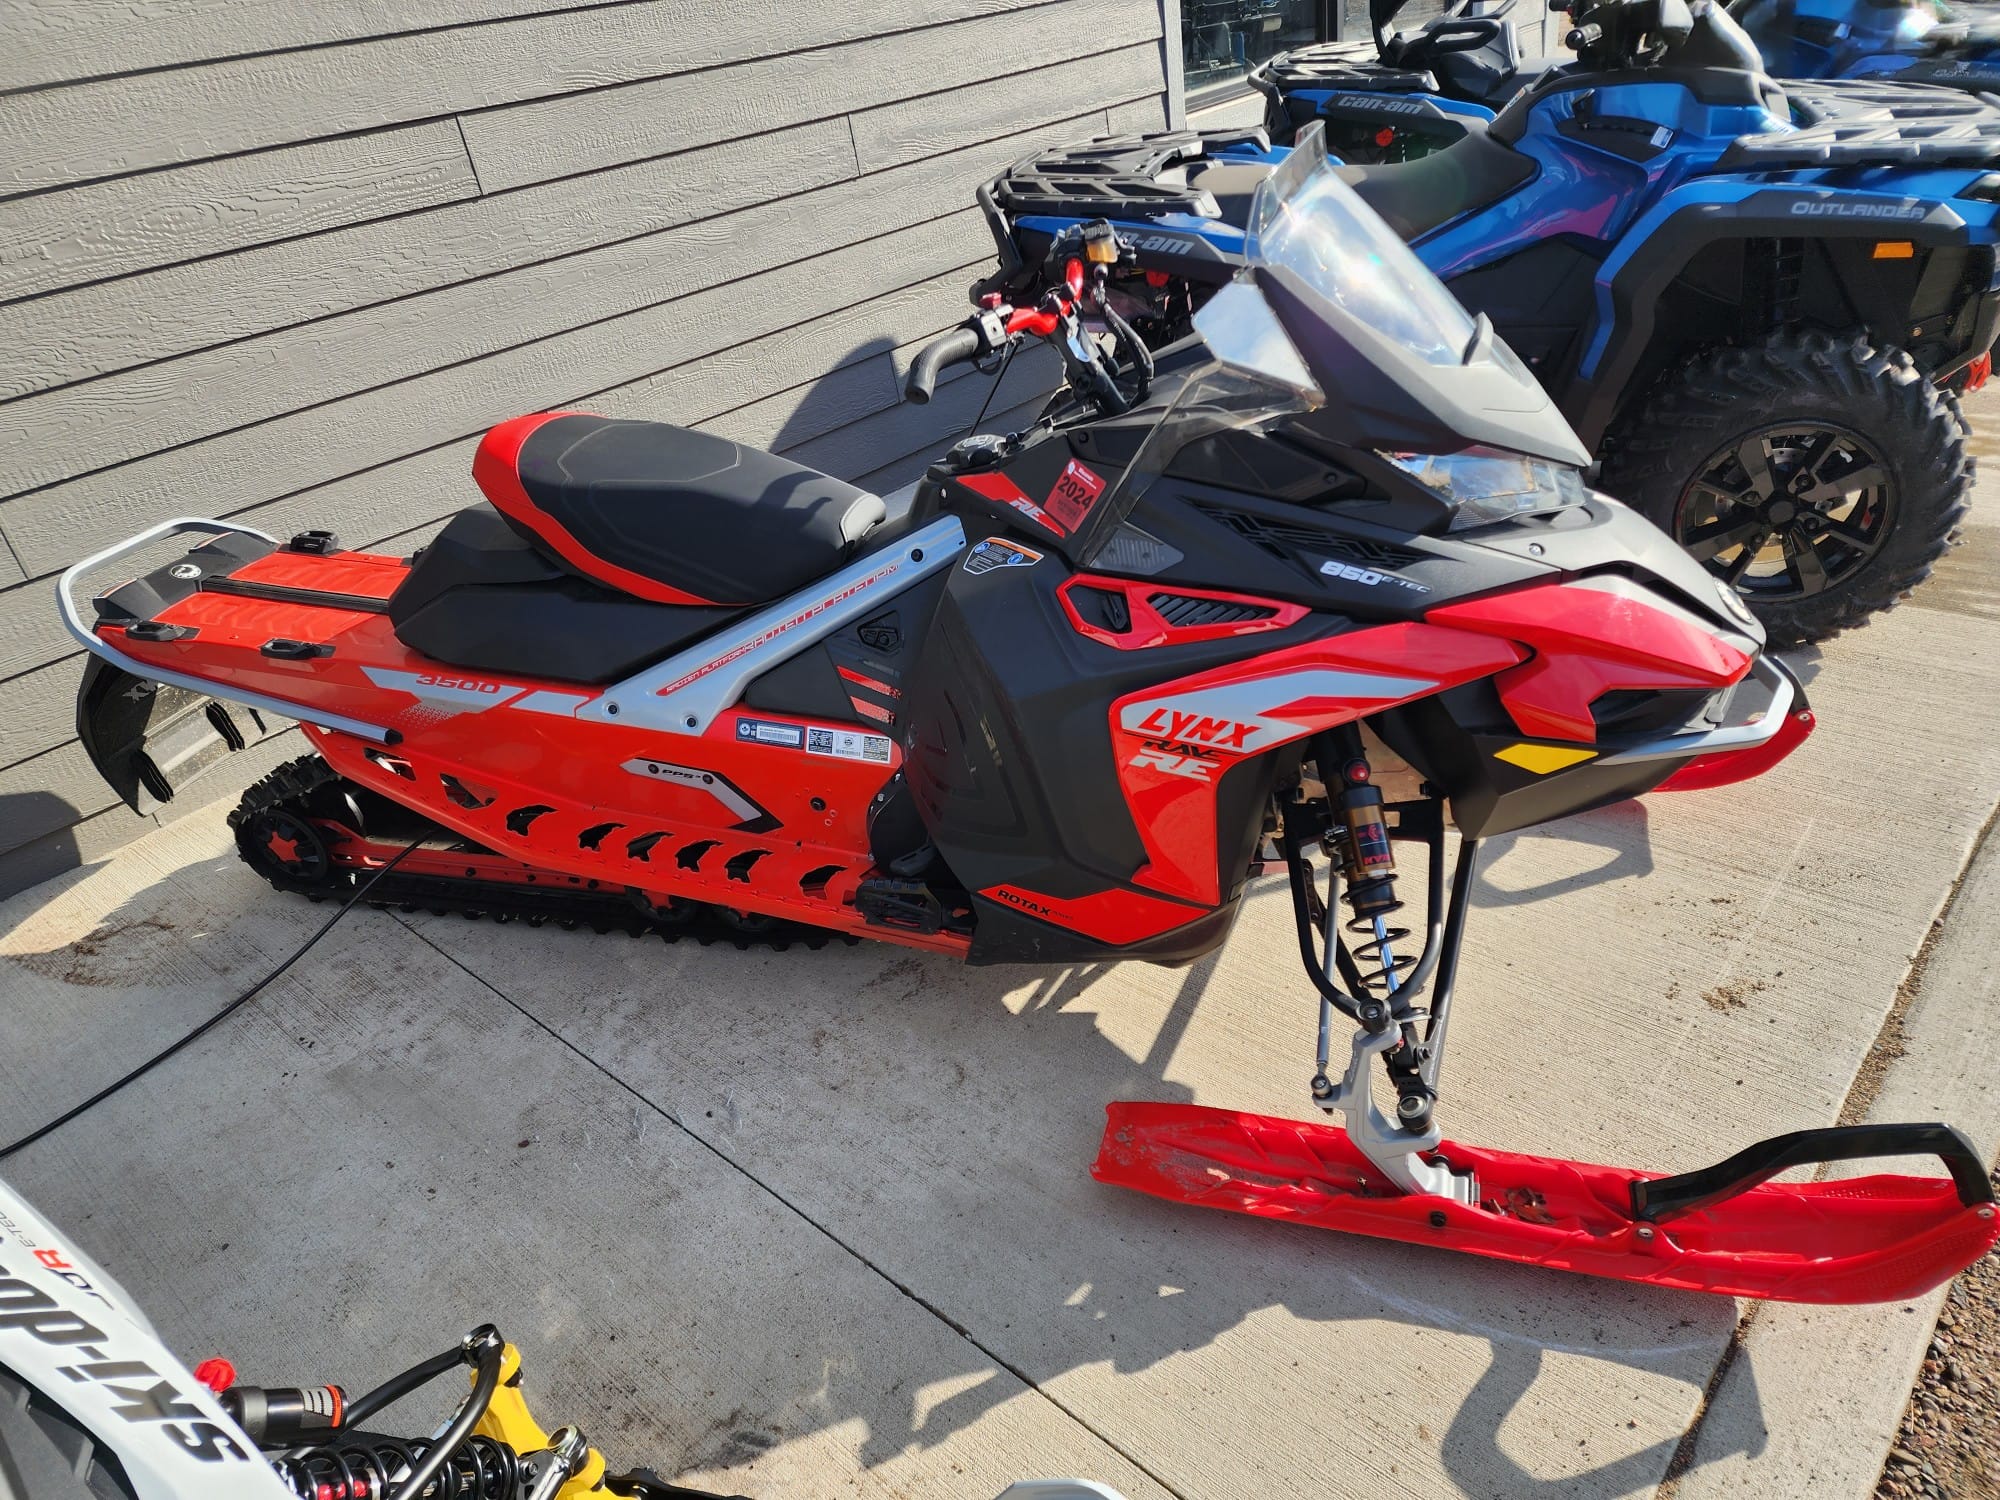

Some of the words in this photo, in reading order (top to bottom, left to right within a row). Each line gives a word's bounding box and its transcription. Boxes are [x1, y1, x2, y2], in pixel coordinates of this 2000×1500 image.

[1337, 95, 1424, 115] can-am
[1790, 201, 1926, 219] OUTLANDER
[1116, 231, 1195, 256] n-am
[1056, 475, 1095, 511] 2024
[1319, 560, 1384, 587] 850
[415, 674, 502, 695] 3500
[1136, 707, 1262, 749] LYNX
[1128, 750, 1221, 783] RE
[997, 889, 1052, 917] ROTAX
